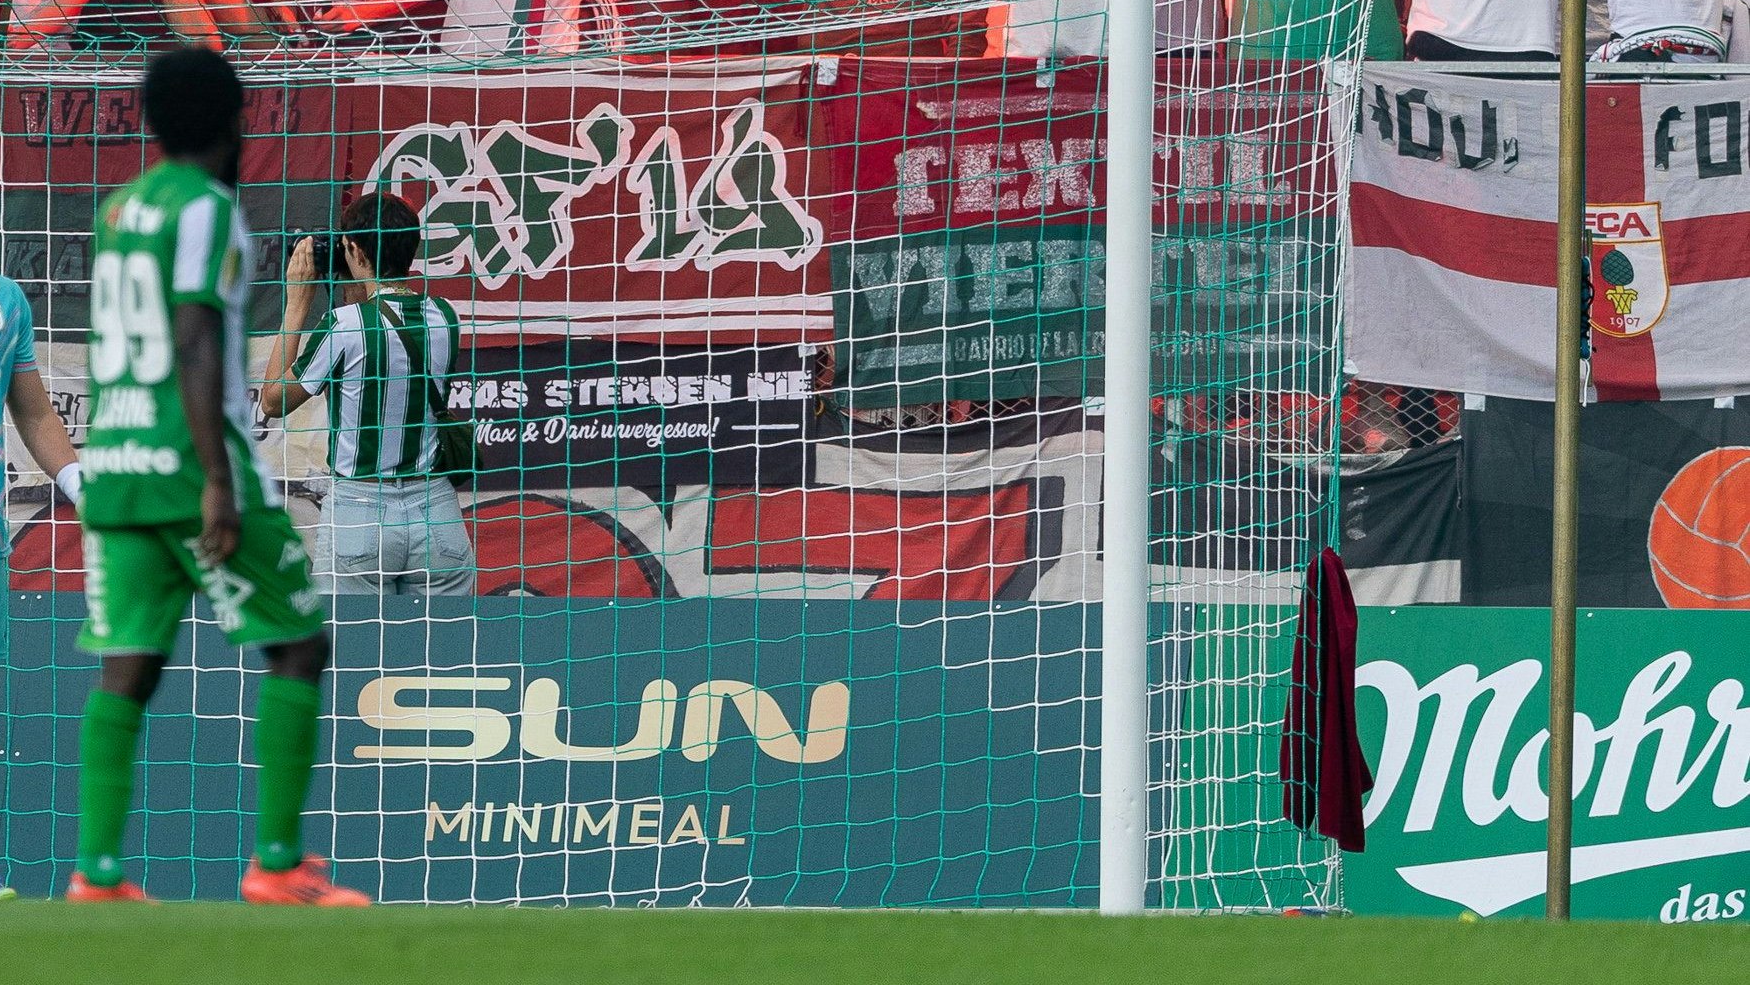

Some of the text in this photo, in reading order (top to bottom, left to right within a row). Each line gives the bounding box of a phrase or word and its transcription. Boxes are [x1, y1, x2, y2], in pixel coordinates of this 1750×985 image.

[893, 133, 1292, 216] TEXIL
[90, 251, 172, 385] 99
[747, 369, 812, 402] NIE
[543, 416, 598, 446] Dani
[353, 676, 851, 763] SUN
[424, 801, 747, 847] MINIMEAL
[1660, 883, 1746, 925] das
